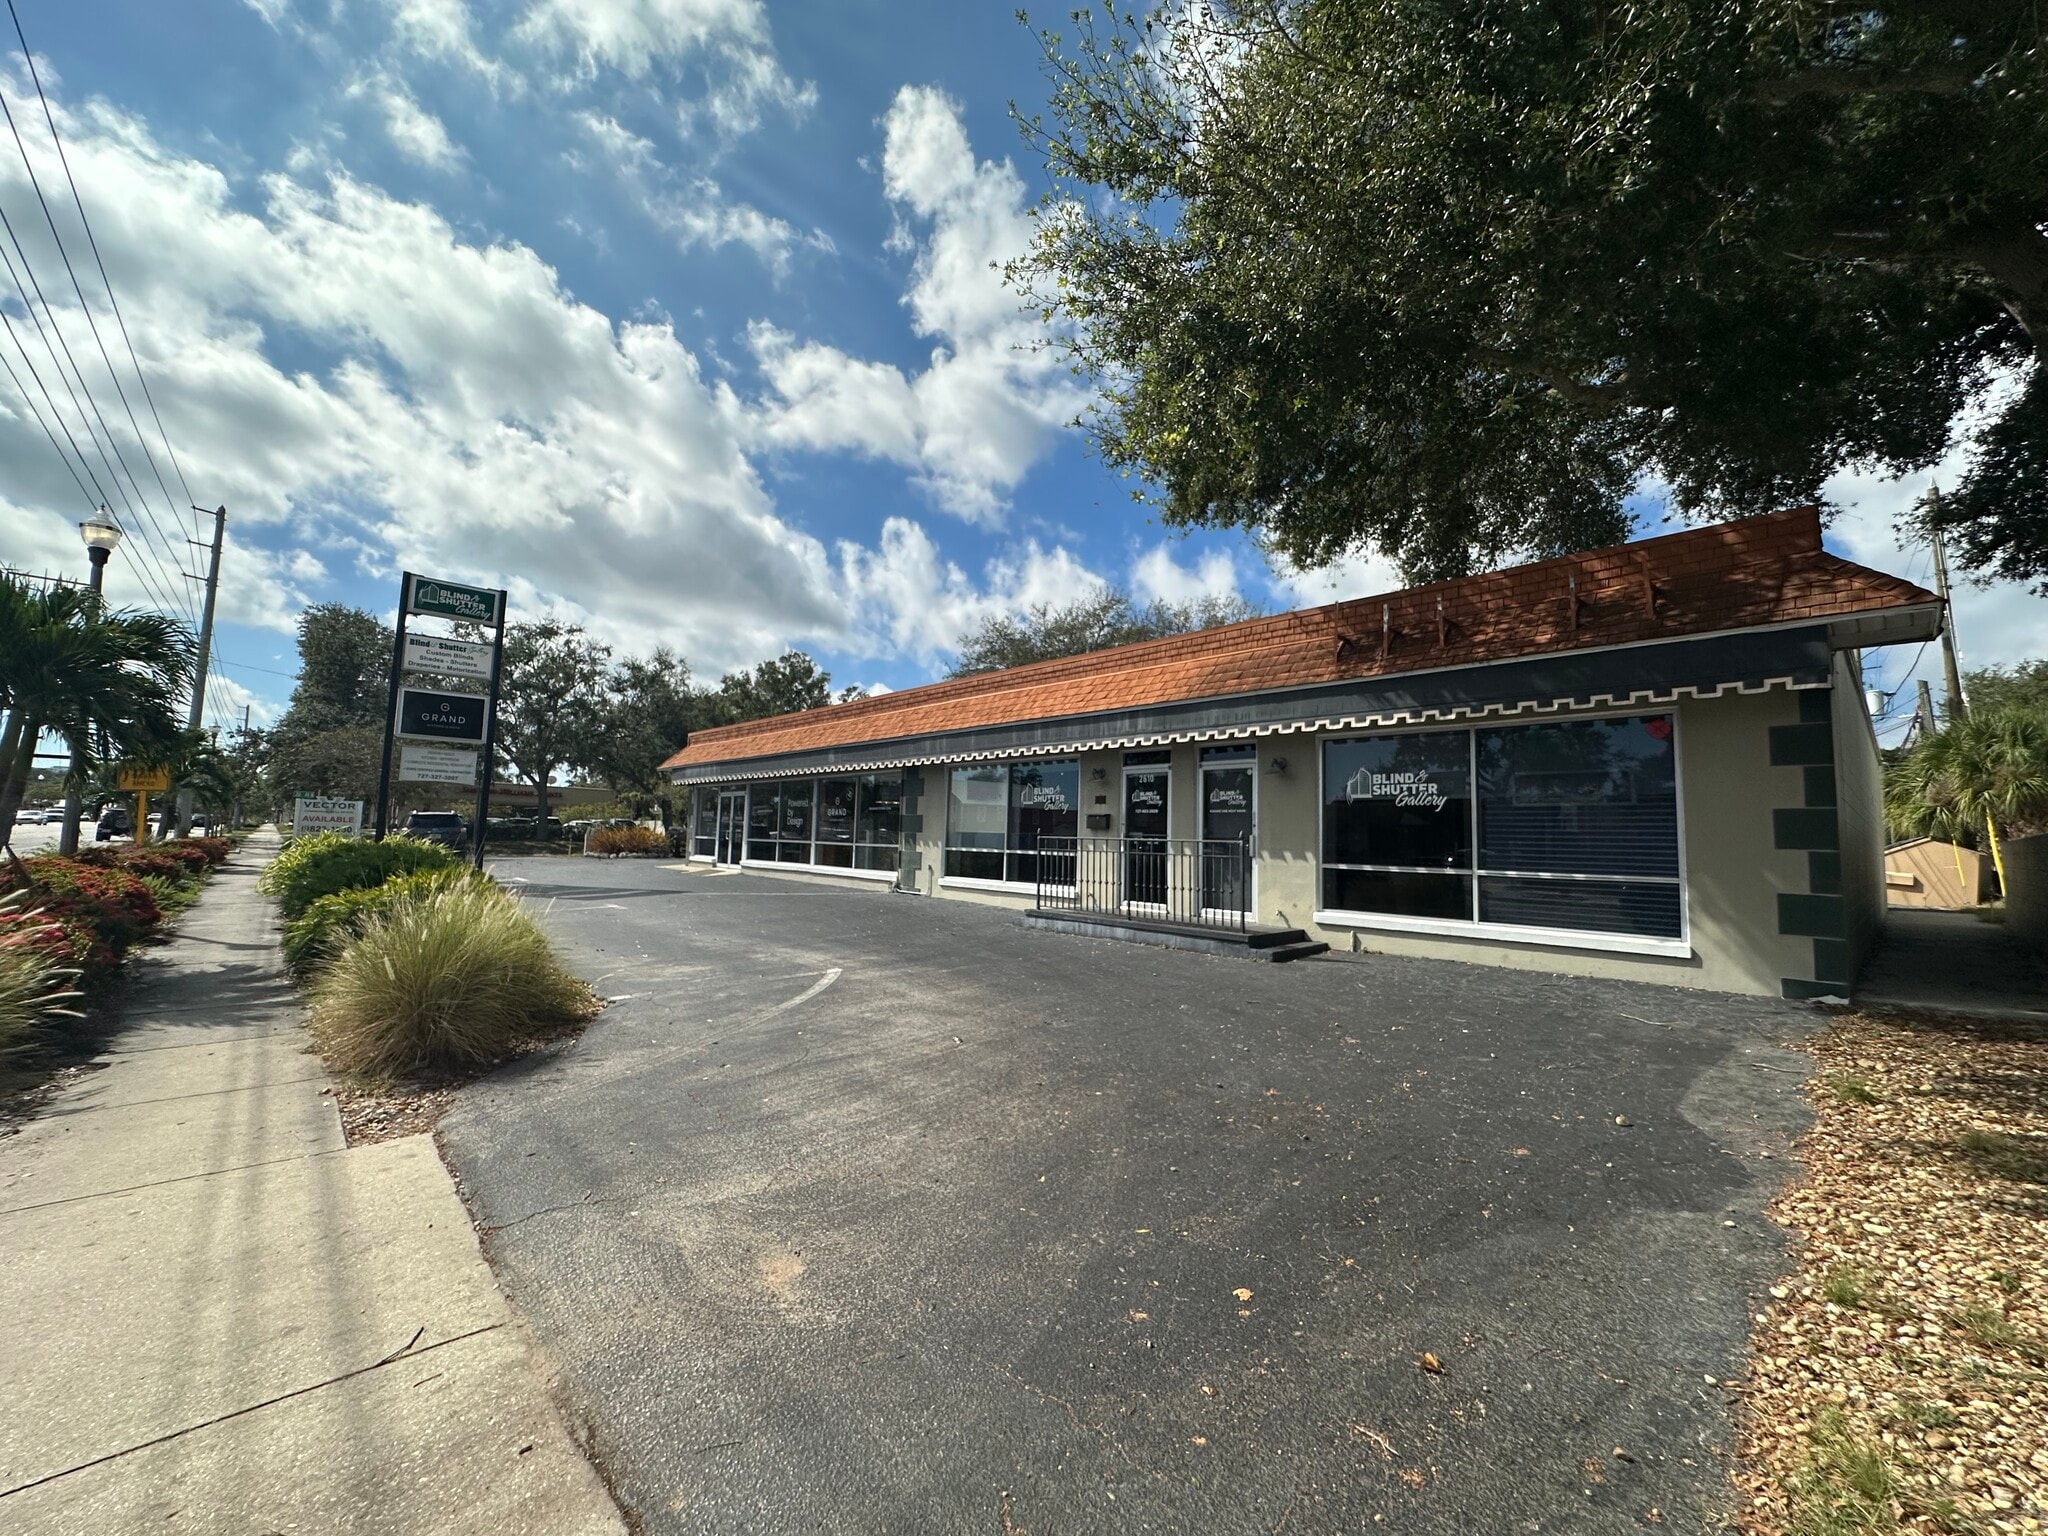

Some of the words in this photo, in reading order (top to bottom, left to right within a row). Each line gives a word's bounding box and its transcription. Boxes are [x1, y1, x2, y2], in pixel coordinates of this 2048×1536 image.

[440, 589, 471, 601] BLIND
[439, 597, 486, 611] SHUTTER
[455, 605, 491, 621] Gallery
[409, 639, 430, 647] Blind
[439, 643, 467, 652] Shutter
[426, 649, 452, 657] Custom
[419, 655, 444, 663] Shades
[450, 659, 477, 667] Shutters
[408, 661, 440, 669] Draperies
[447, 666, 486, 675] Motorization
[421, 713, 466, 724] GRAND
[1373, 773, 1414, 784] BLIND
[1415, 769, 1428, 783] &
[1373, 783, 1438, 795] SHUTTER
[788, 799, 808, 807] Powered
[1044, 800, 1069, 815] Gallery
[1395, 791, 1447, 812] Gallery
[827, 808, 847, 816] GRAND
[787, 817, 803, 828] Design
